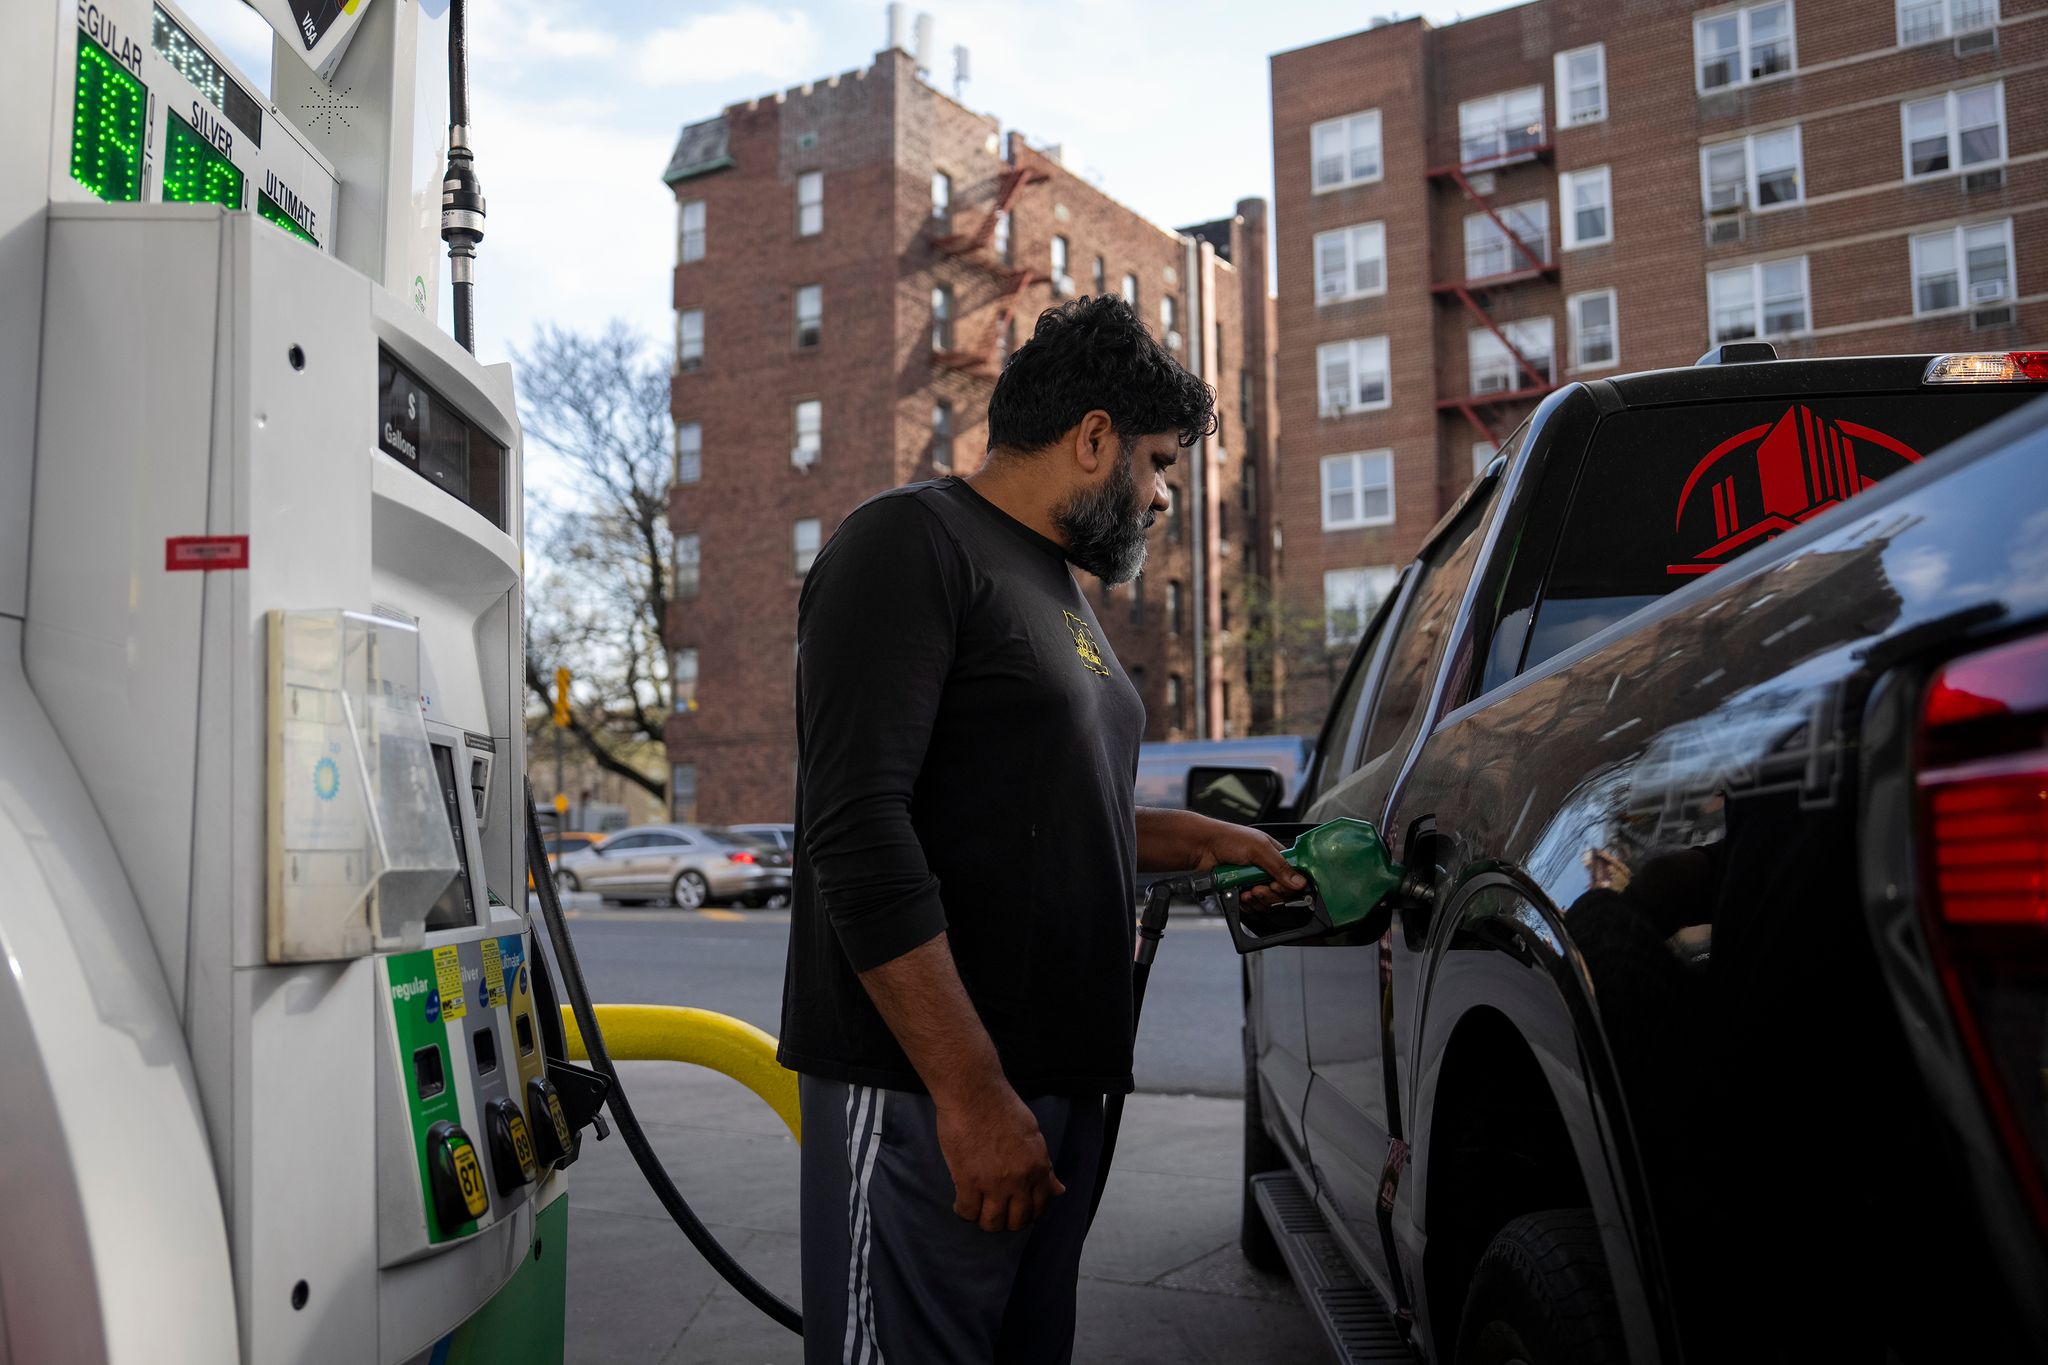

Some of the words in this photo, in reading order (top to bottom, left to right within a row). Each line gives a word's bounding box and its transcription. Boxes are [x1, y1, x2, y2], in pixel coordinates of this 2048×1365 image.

[78, 0, 142, 77] EGULAR
[302, 10, 318, 45] VISA
[191, 100, 233, 161] SILVER
[266, 168, 316, 237] ULTIMATE
[384, 422, 417, 461] Gallons
[392, 976, 429, 1002] regular
[460, 964, 480, 983] ilver
[515, 1132, 529, 1161] 89
[460, 1161, 480, 1197] 87
